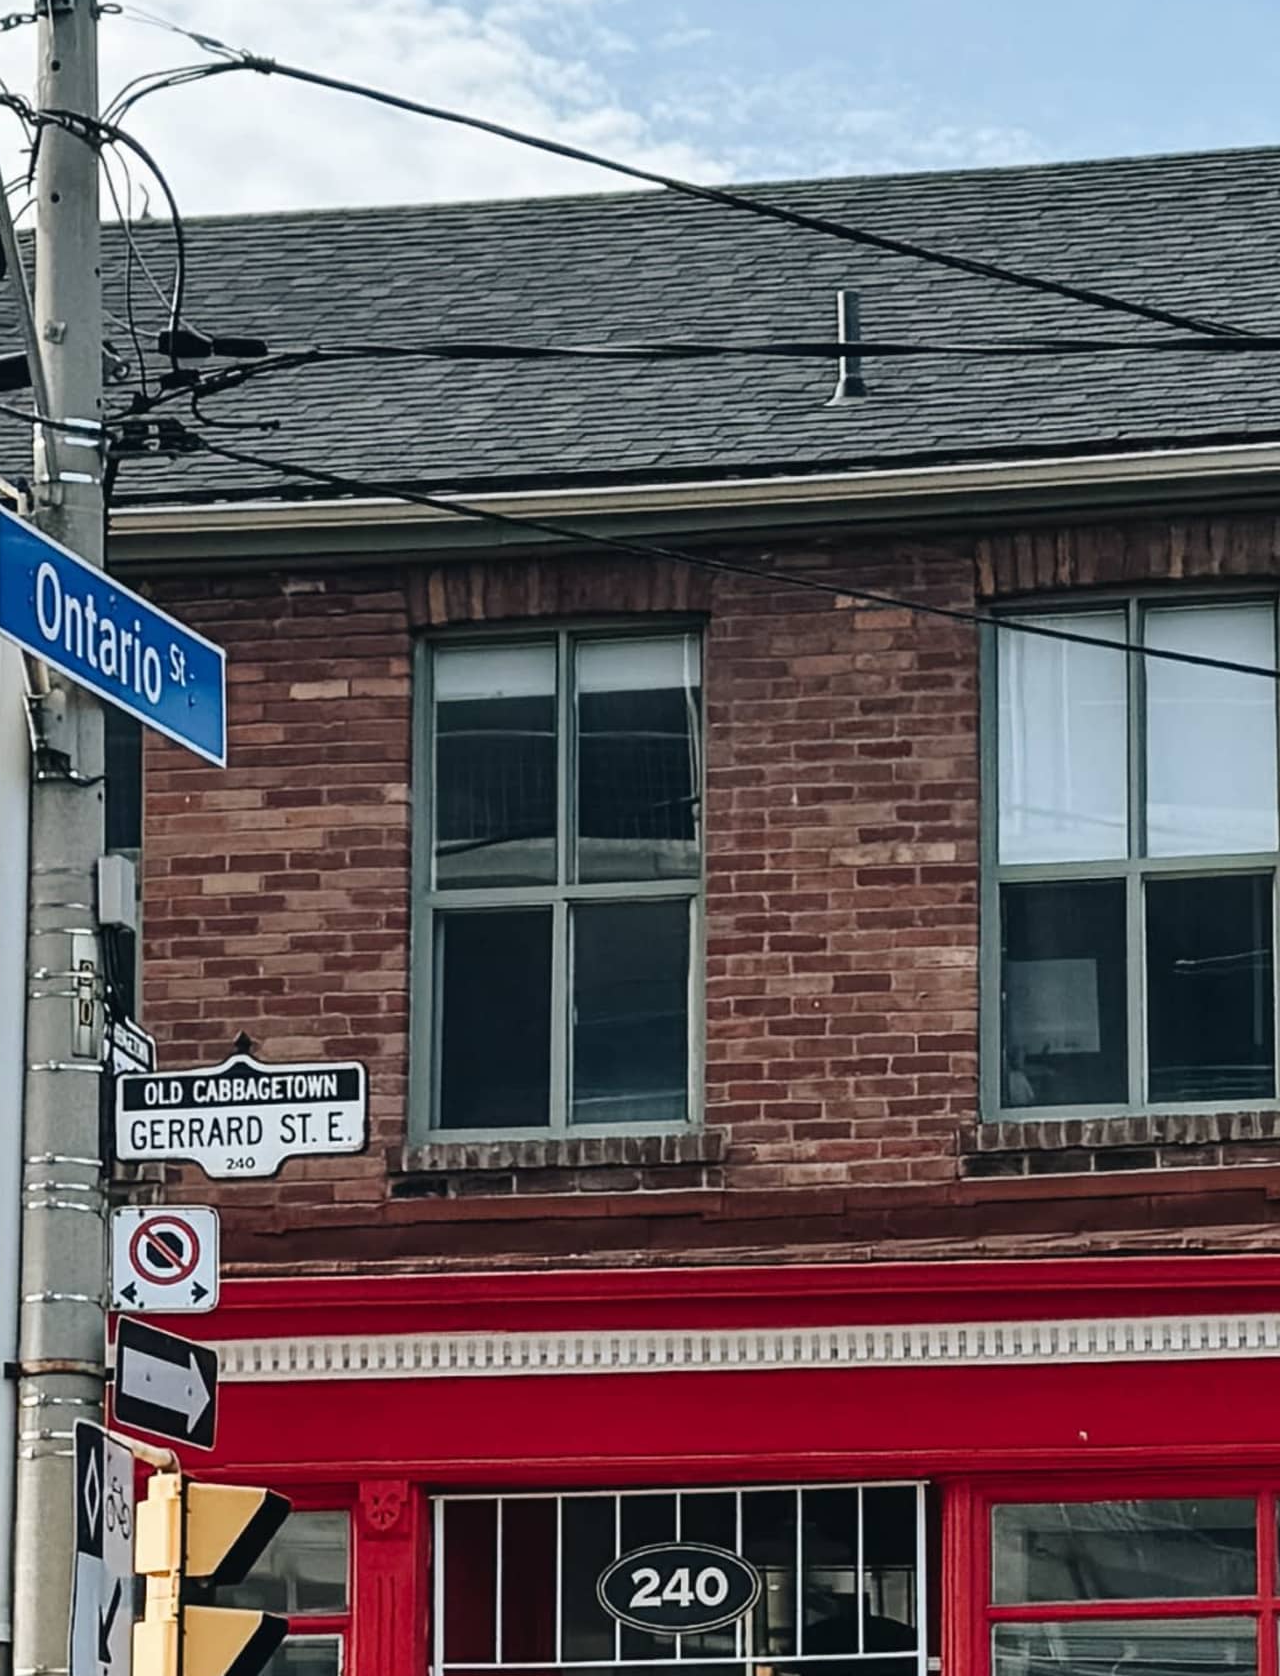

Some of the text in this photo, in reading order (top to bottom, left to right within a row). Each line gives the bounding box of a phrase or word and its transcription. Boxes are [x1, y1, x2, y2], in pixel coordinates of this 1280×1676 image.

[36, 561, 162, 704] Ontario
[144, 1073, 338, 1105] OLD CABBAGETOWN
[131, 1111, 352, 1150] GERRARD ST. E.
[225, 1156, 256, 1170] 240
[629, 1566, 729, 1608] 240
